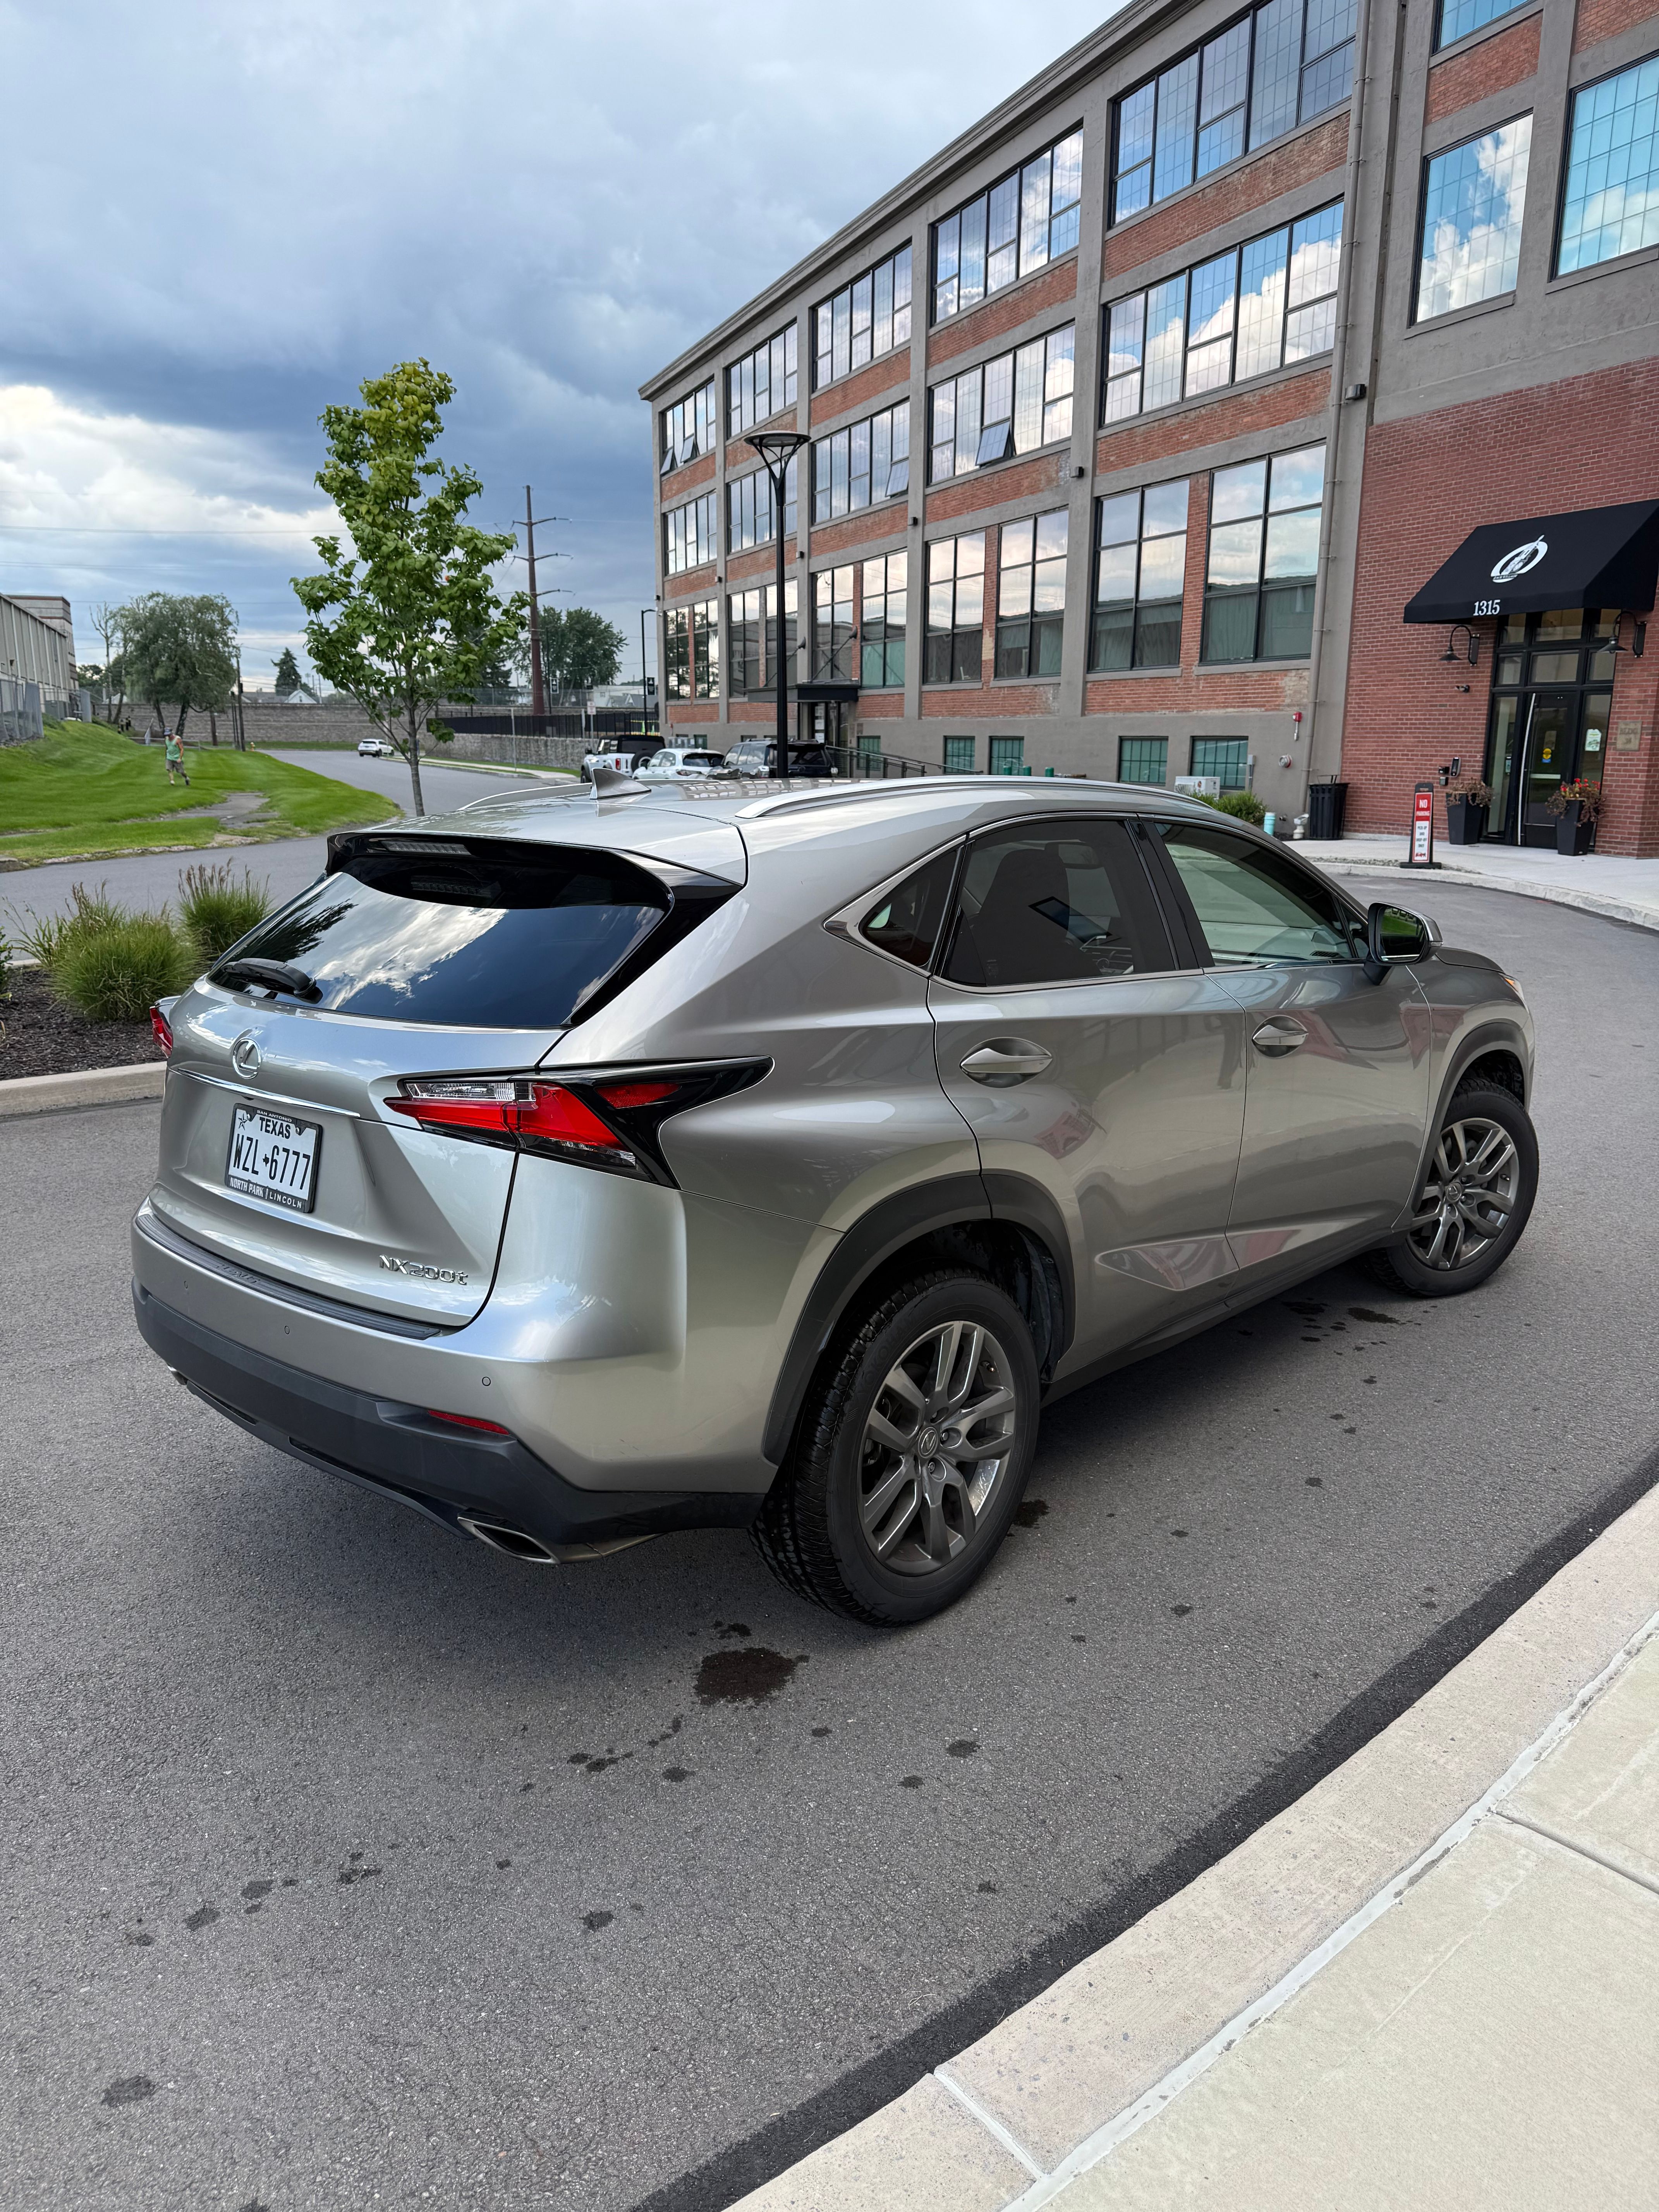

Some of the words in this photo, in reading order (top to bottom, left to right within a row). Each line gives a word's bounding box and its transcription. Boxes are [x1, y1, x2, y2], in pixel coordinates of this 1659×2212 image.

[1473, 599, 1501, 616] 1315
[1419, 799, 1428, 808] NO
[268, 1113, 292, 1122] ANTONIO
[259, 1116, 291, 1139] TEXAS
[230, 1177, 248, 1192] NORTH
[249, 1183, 264, 1197] PARK
[269, 1191, 302, 1209] LINCOLN
